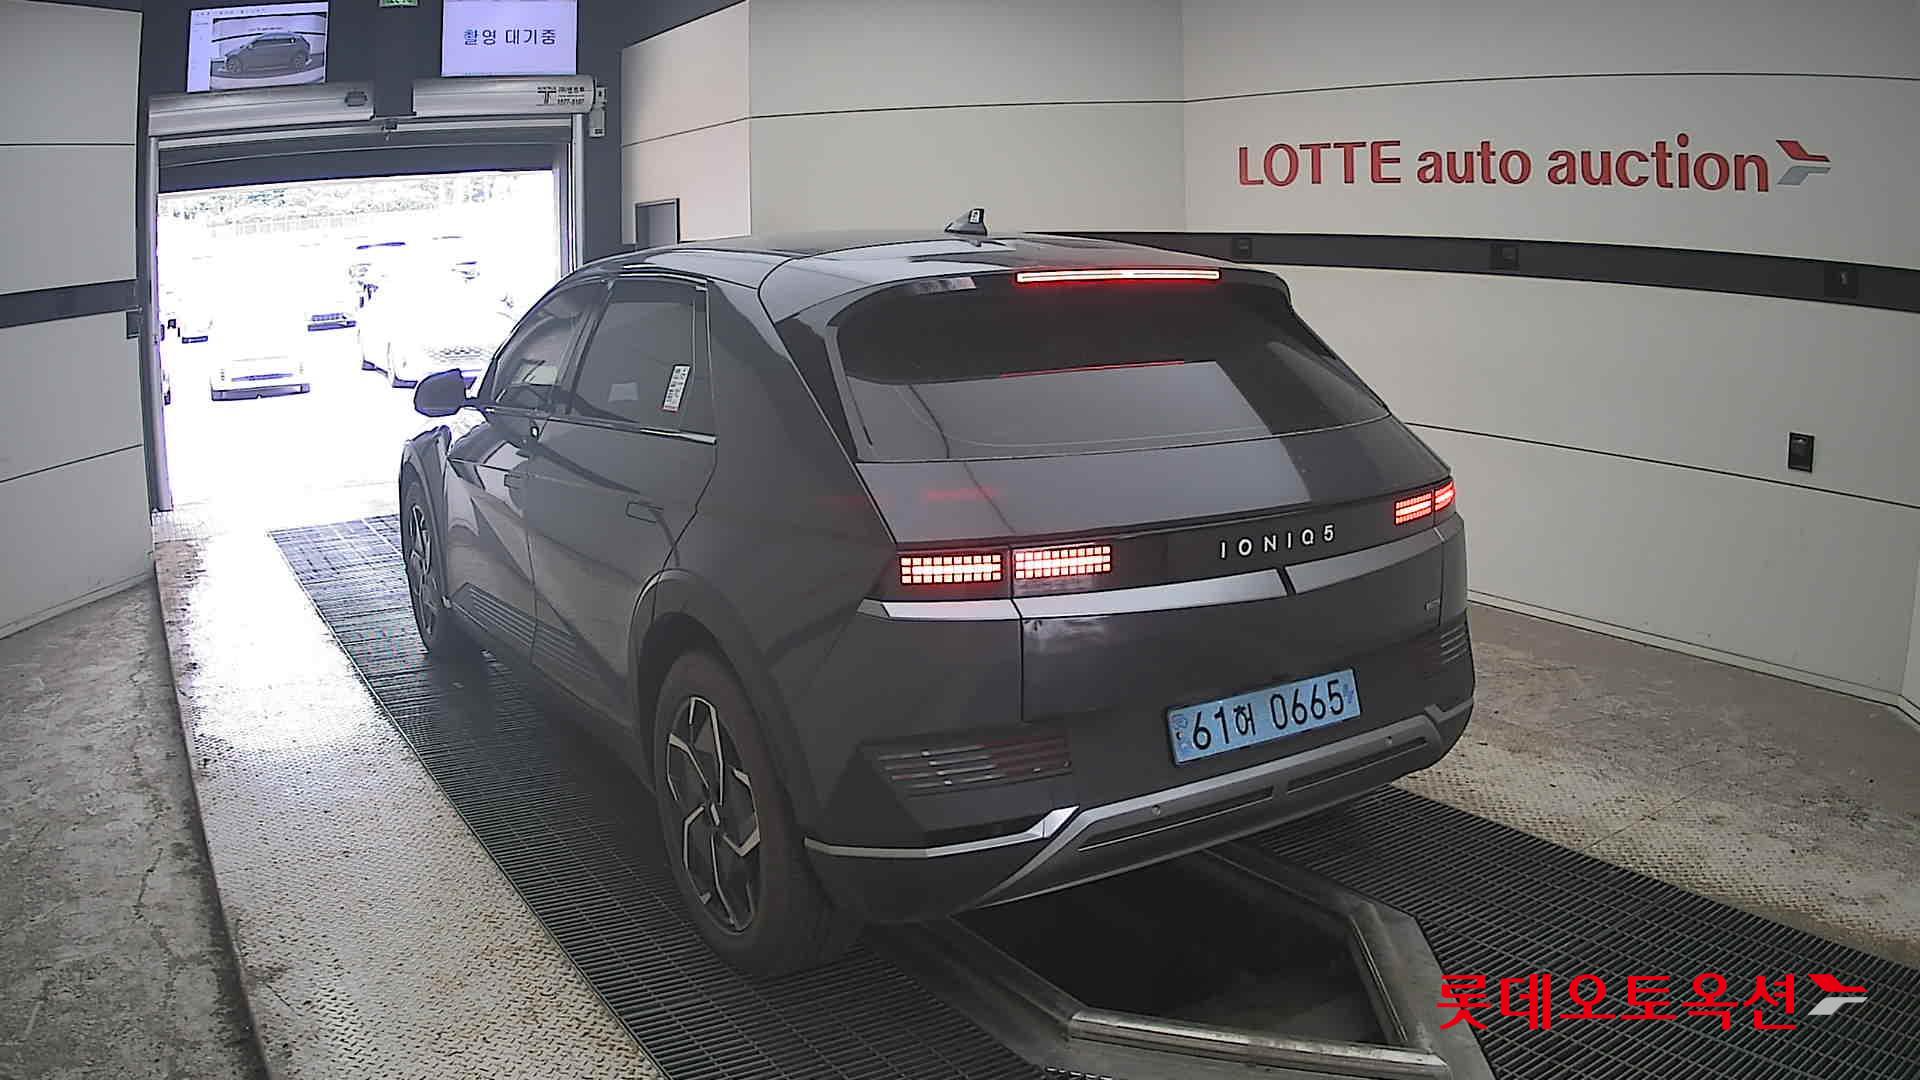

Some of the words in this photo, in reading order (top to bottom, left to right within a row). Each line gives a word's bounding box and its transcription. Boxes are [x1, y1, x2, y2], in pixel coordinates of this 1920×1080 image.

[505, 28, 556, 46] 대기중
[1239, 140, 1400, 187] LOTTE
[1416, 141, 1532, 185] auto
[1548, 134, 1769, 192] auction
[1269, 679, 1345, 730] 0665
